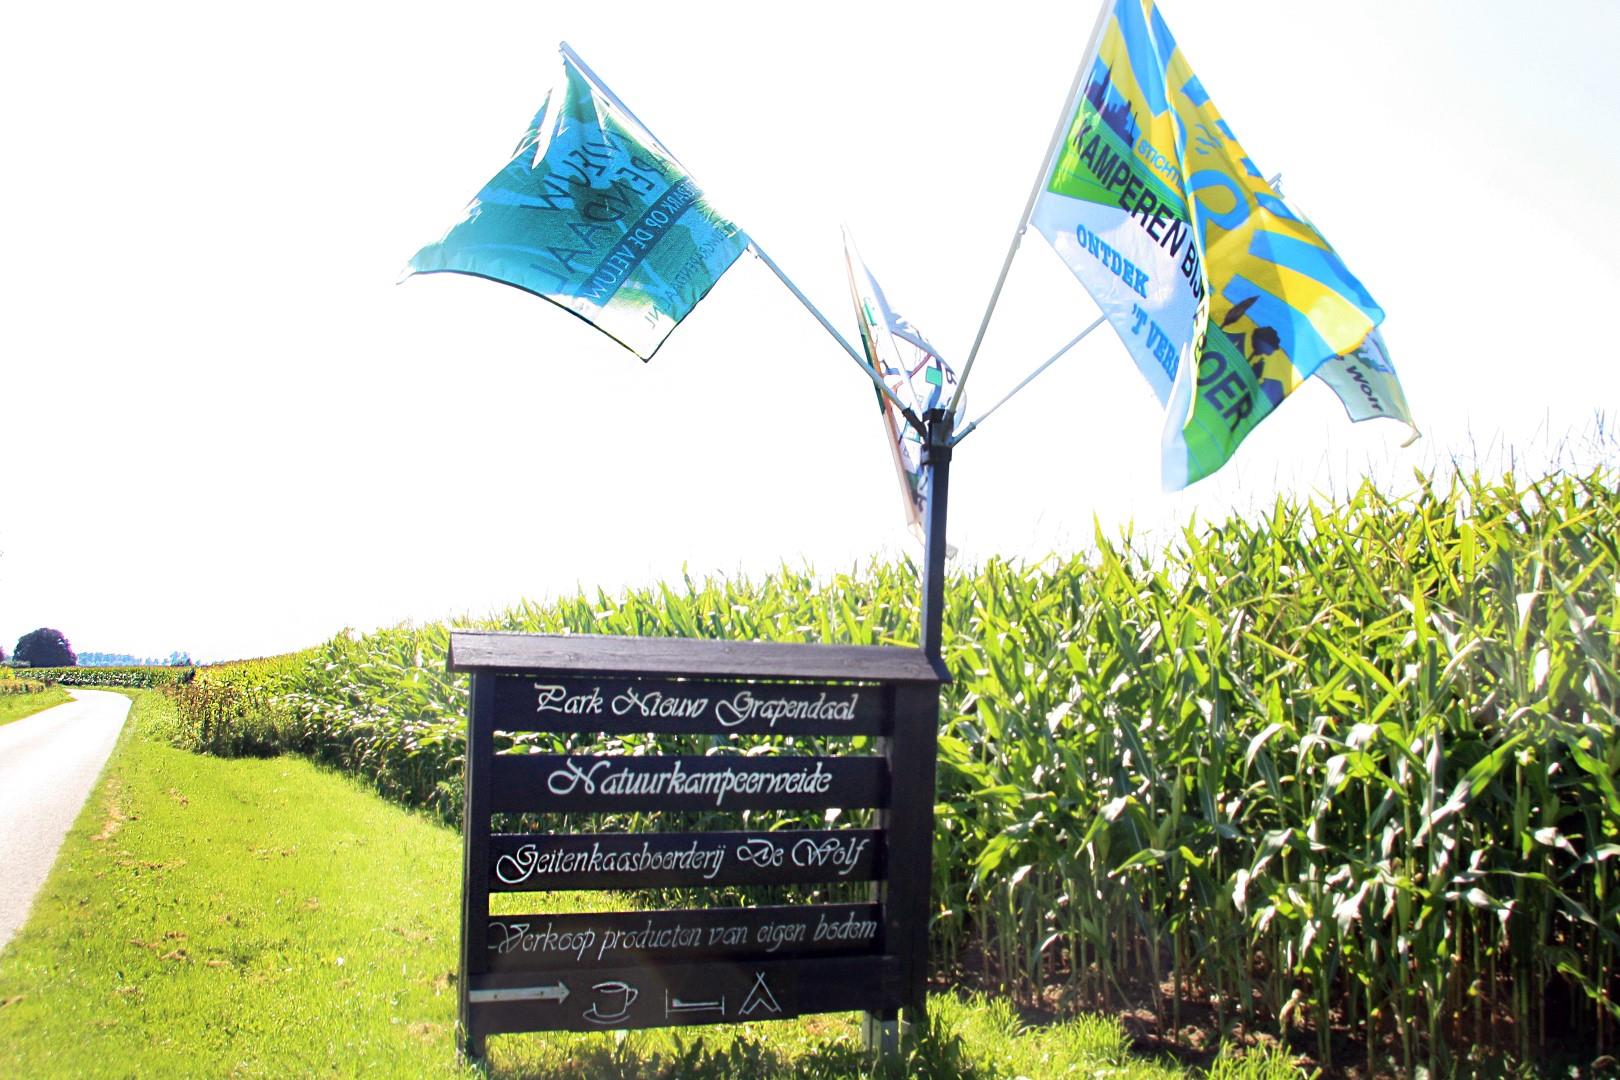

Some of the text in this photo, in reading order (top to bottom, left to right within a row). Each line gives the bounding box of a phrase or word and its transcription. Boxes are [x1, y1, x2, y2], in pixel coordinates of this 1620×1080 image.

[1073, 120, 1187, 258] KAMPEREN
[1077, 224, 1149, 298] ONTDEK
[534, 682, 858, 727] Park Nieuw Grapendaal
[547, 758, 832, 805] Natuurkampeerweide
[496, 837, 870, 885] Geitenkaasboerderij De Wolf
[487, 914, 877, 961] Verkoop producten van eigen bodem
